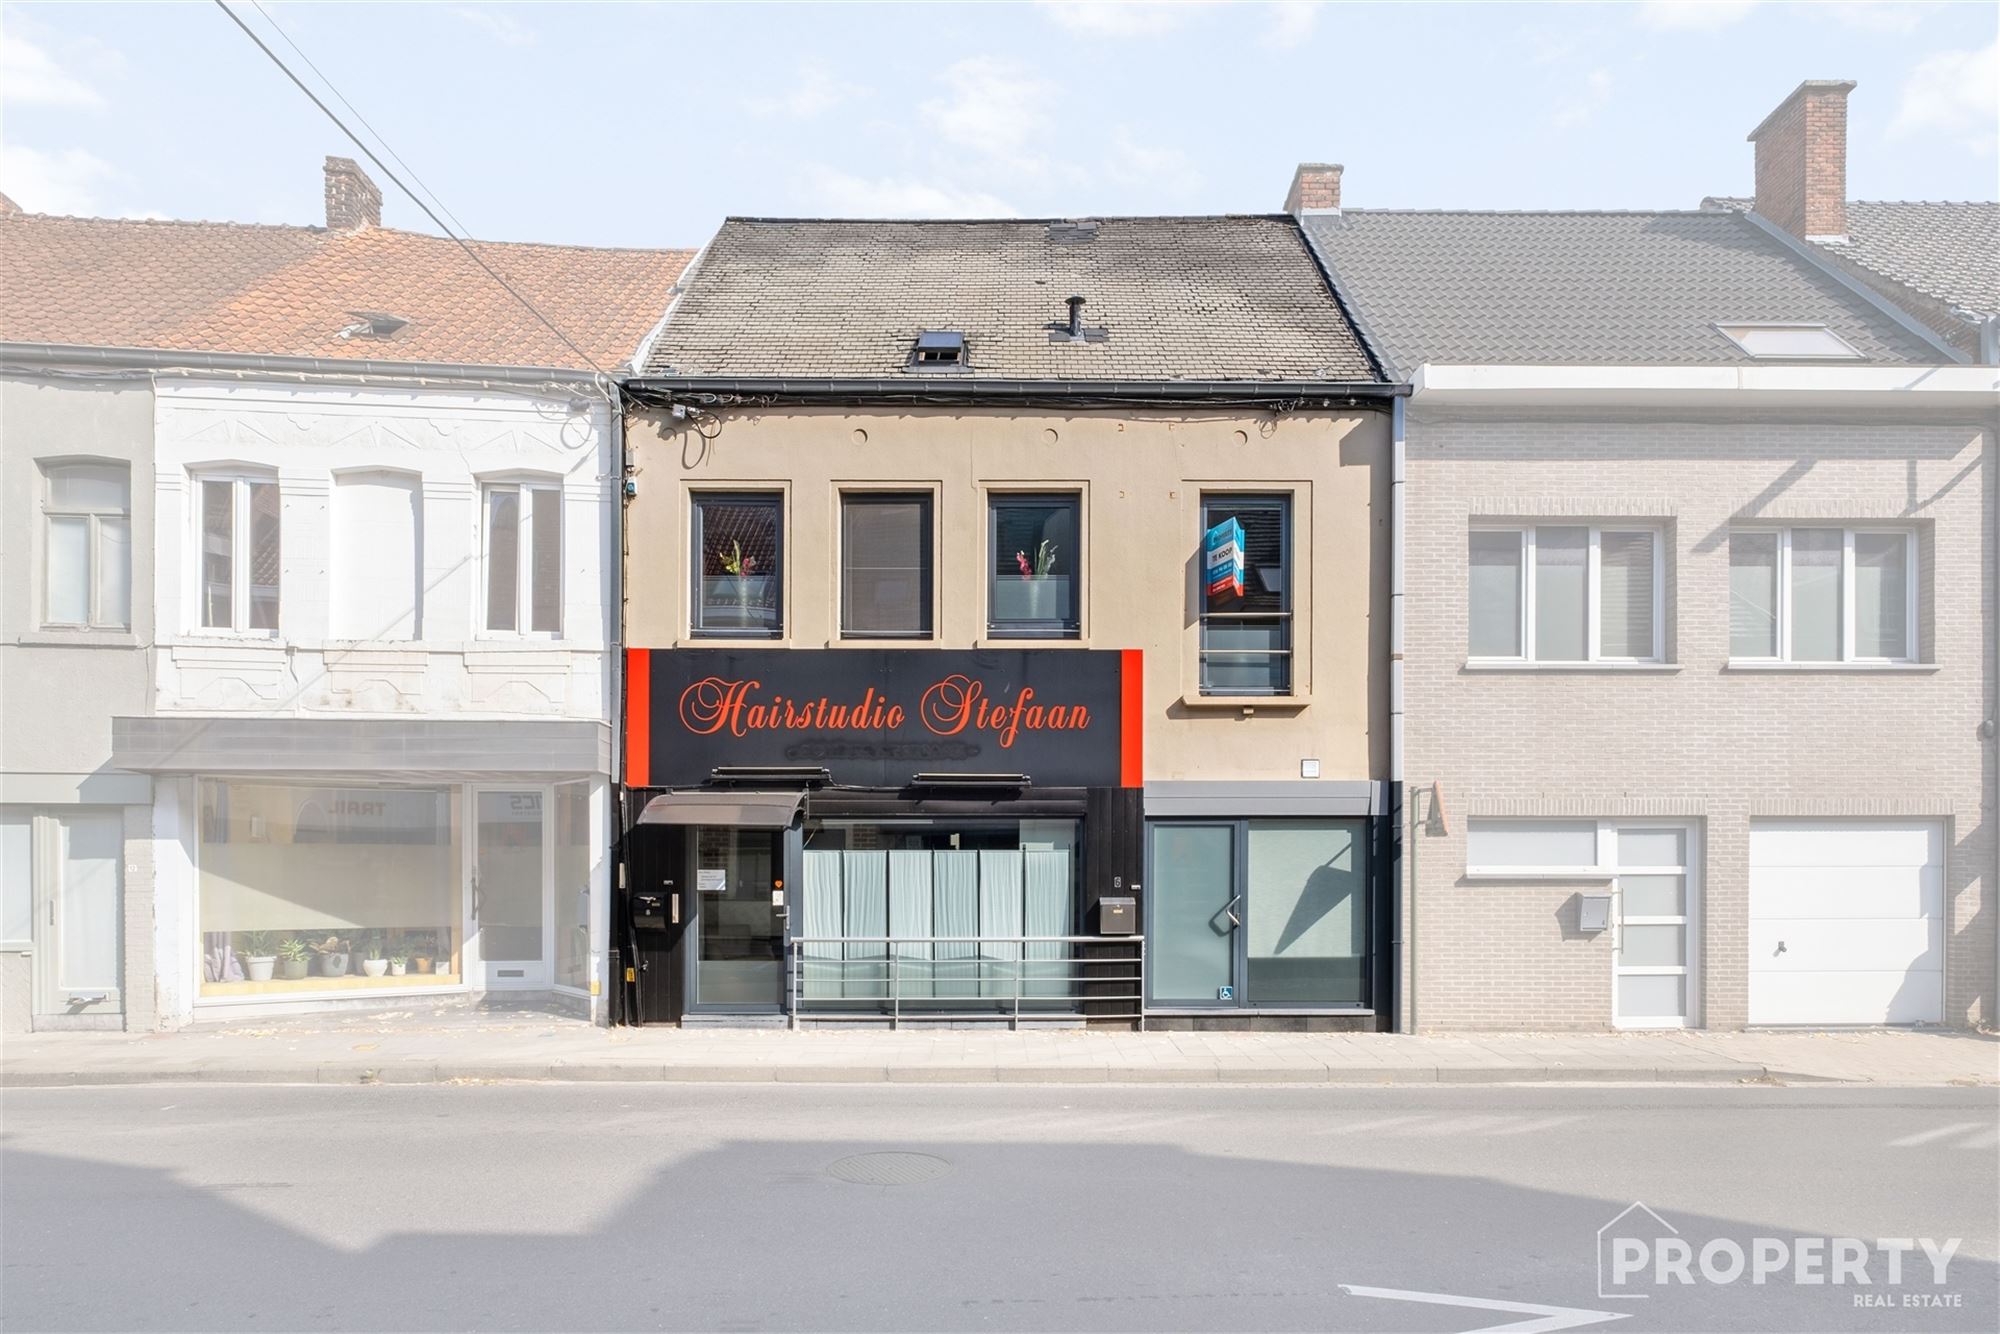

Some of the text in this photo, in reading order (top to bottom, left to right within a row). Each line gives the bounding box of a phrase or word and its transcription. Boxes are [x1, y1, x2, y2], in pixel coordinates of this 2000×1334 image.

[1218, 546, 1233, 559] KOOP
[679, 674, 1092, 748] Hairstudio Stefaan
